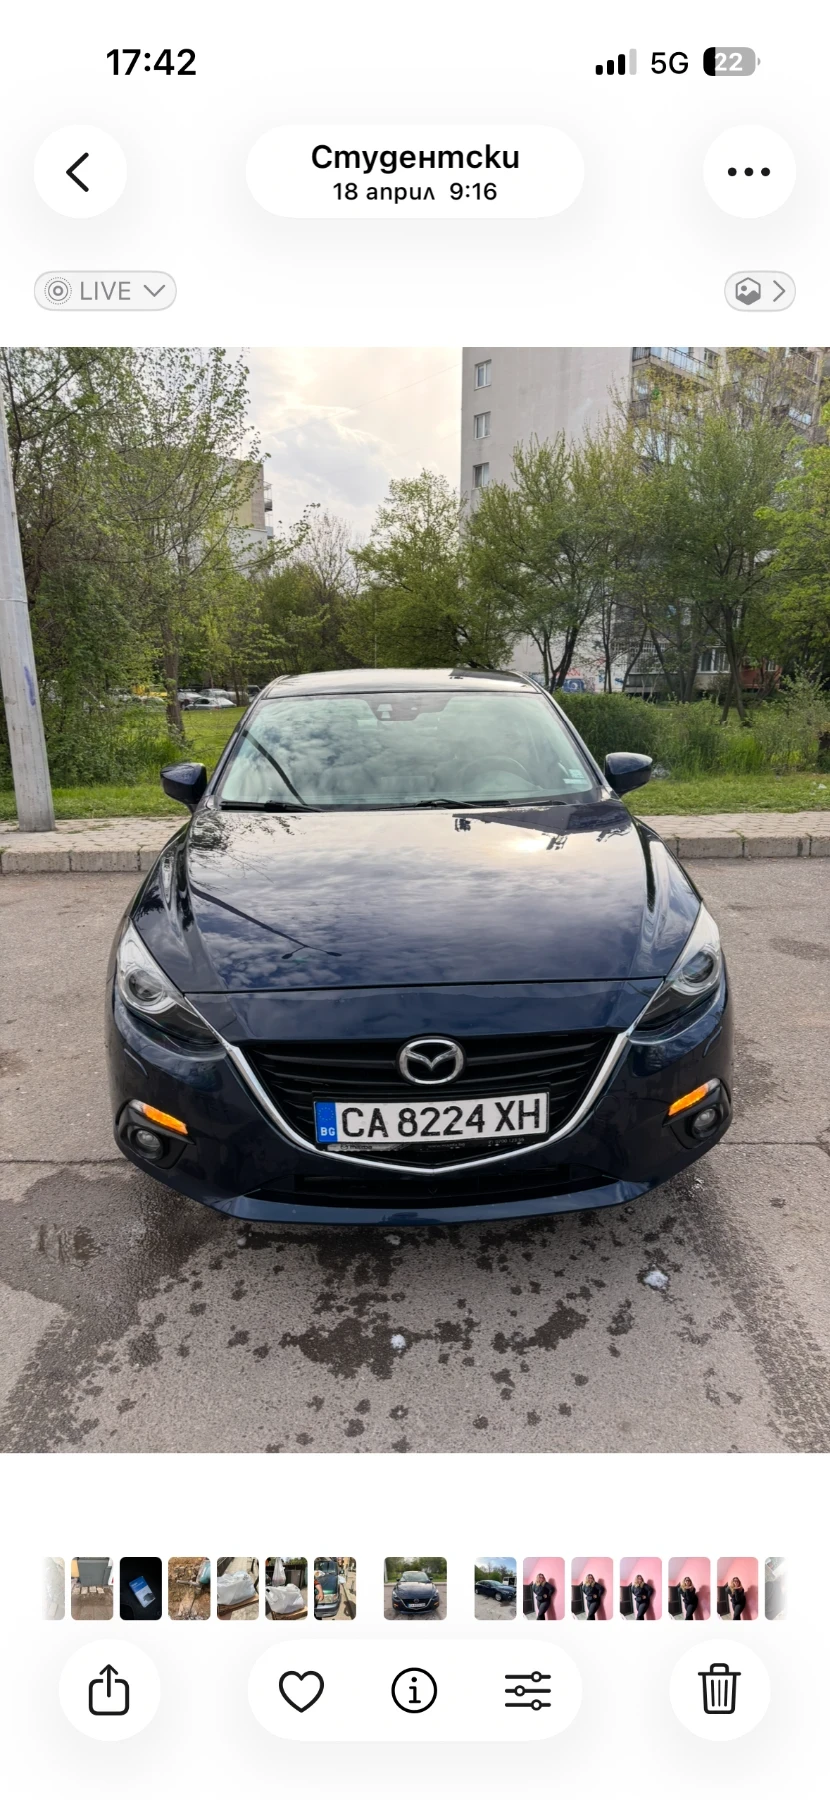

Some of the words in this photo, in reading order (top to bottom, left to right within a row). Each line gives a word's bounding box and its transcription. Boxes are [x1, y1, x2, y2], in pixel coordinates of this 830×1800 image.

[341, 1107, 389, 1138] CA
[397, 1103, 485, 1138] 8224
[494, 1098, 540, 1132] XH
[320, 1126, 336, 1137] BG
